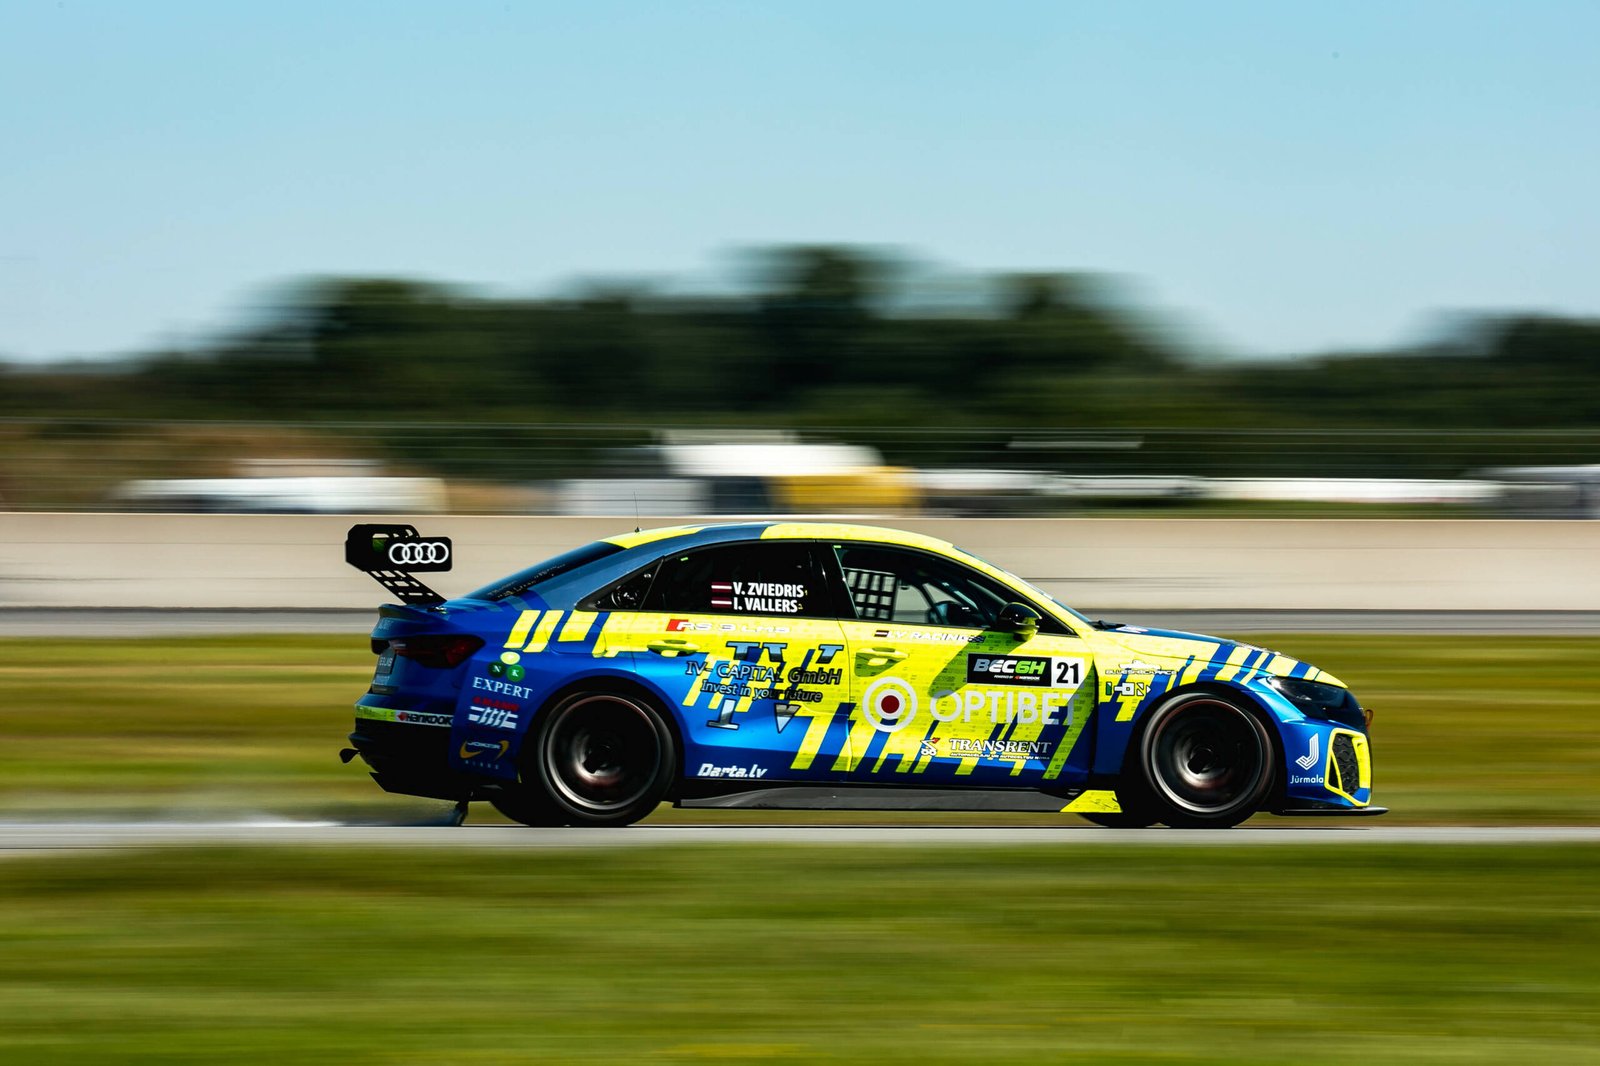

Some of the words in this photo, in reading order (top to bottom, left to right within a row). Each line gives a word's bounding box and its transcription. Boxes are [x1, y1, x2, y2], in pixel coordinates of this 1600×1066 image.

[733, 582, 746, 595] V.
[748, 583, 804, 598] ZVIEDRIS
[733, 597, 743, 610] I.
[744, 598, 798, 613] VALLERS
[716, 664, 783, 682] CAPITAL
[787, 666, 843, 685] GmbH
[973, 658, 1046, 674] BEC6H
[1056, 661, 1079, 684] 21
[472, 676, 533, 699] EXPERT
[700, 679, 737, 695] Invest
[739, 684, 752, 697] in
[753, 687, 780, 701] your
[784, 688, 823, 702] future
[930, 689, 1081, 726] OPTIBET
[949, 737, 1052, 754] TRANSRENT
[697, 763, 768, 778] Darta.lv
[1290, 774, 1324, 784] Jūrmala
